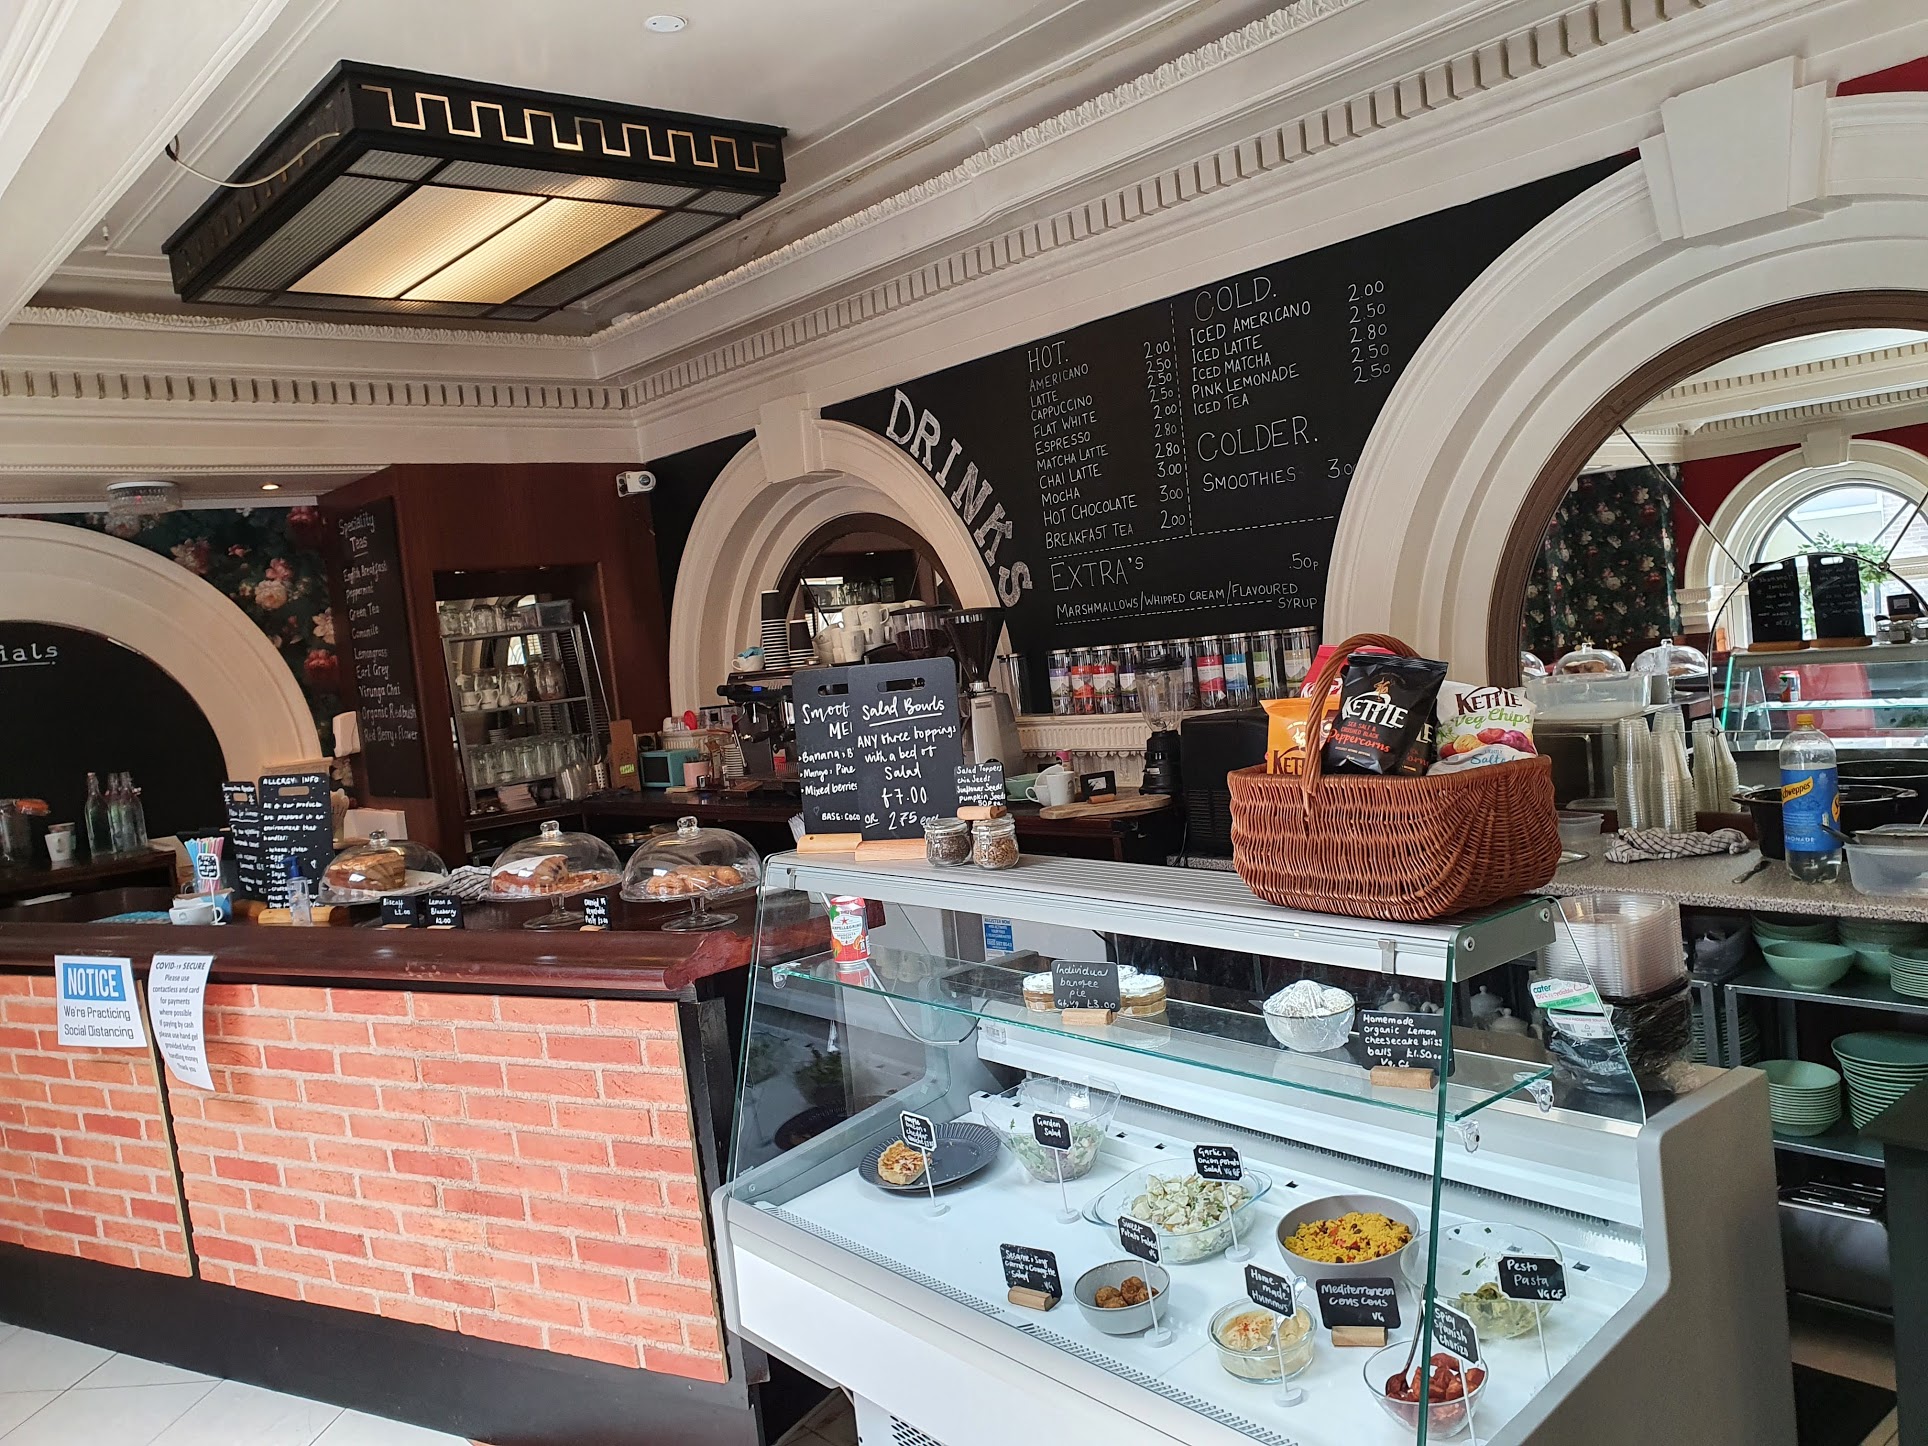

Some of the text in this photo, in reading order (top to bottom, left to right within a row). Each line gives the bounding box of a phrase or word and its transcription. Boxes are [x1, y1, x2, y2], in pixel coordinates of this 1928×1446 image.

[1190, 280, 1385, 346] ICED AMERICANO 2.00
[1191, 302, 1386, 364] ICED LATTE 2.50
[1192, 323, 1388, 382] ICED MATCHA 2.80
[1029, 340, 1171, 392] AMERICANO 2.00
[1191, 343, 1390, 400] PINK LEMONADE 2.50
[1030, 357, 1172, 408] LATTE 2.50
[1193, 362, 1391, 416] ICED TEA 2.50
[1030, 372, 1172, 421] CAPPUCCINO 2.50
[1033, 420, 1058, 439] FLAT
[1061, 410, 1098, 430] WHITE
[1035, 403, 1178, 456] ESPRESSO 2.00
[1036, 422, 1178, 472] MATCHA LATTE 2.80
[1039, 441, 1180, 490] CHAI LATTE 2.80
[1041, 461, 1182, 507] MOCHA 3.00
[1202, 466, 1297, 492] SMOOTHIES
[885, 388, 1034, 608] DRINKS
[1043, 507, 1067, 527] HOT
[1071, 494, 1138, 520] CHOCOLATE
[1045, 524, 1108, 550] BREAKFAST
[1111, 522, 1134, 537] TEA
[1277, 596, 1318, 610] SYRUP
[801, 702, 851, 725] Smoot
[862, 695, 945, 721] Salad Bowls
[1341, 691, 1409, 729] KETTLE
[1452, 707, 1531, 729] Veg Chips
[857, 725, 957, 749] ANY three toppings
[1326, 727, 1391, 753] Peppercorns
[864, 744, 937, 763] with a bed of
[1273, 749, 1305, 775] KET
[884, 761, 922, 781] Salad
[956, 765, 977, 775] Salad
[262, 776, 320, 786] ALLERGY INFO
[804, 783, 831, 797] Mixed
[1782, 781, 1811, 799] chweppes
[958, 792, 989, 804] pumpkin
[864, 812, 879, 824] OR
[182, 962, 206, 970] SECURE
[67, 967, 120, 998] NOTICE
[1532, 984, 1552, 994] cater
[167, 998, 191, 1006] payments
[1069, 989, 1087, 998] pie
[63, 1005, 131, 1022] We're Practicing
[159, 1008, 173, 1016] where
[1362, 1014, 1415, 1027] Homemade
[64, 1023, 134, 1039] Social Distancing
[177, 1021, 184, 1029] by
[1363, 1026, 1400, 1036] organic
[1364, 1036, 1443, 1047] cheesecake bliss
[1367, 1046, 1392, 1057] balls
[1036, 1116, 1061, 1129] Garden
[1044, 1127, 1062, 1138] Salad
[1198, 1147, 1222, 1158] Garlic
[1203, 1165, 1223, 1175] Salad
[1506, 1259, 1538, 1272] Pesto
[1321, 1283, 1395, 1296] Mediterranean
[1513, 1274, 1550, 1287] Pasta
[1251, 1289, 1289, 1313] Hummus
[1261, 1284, 1289, 1300] made
[1434, 1307, 1456, 1331] Spicy
[1433, 1318, 1468, 1344] Spanish
